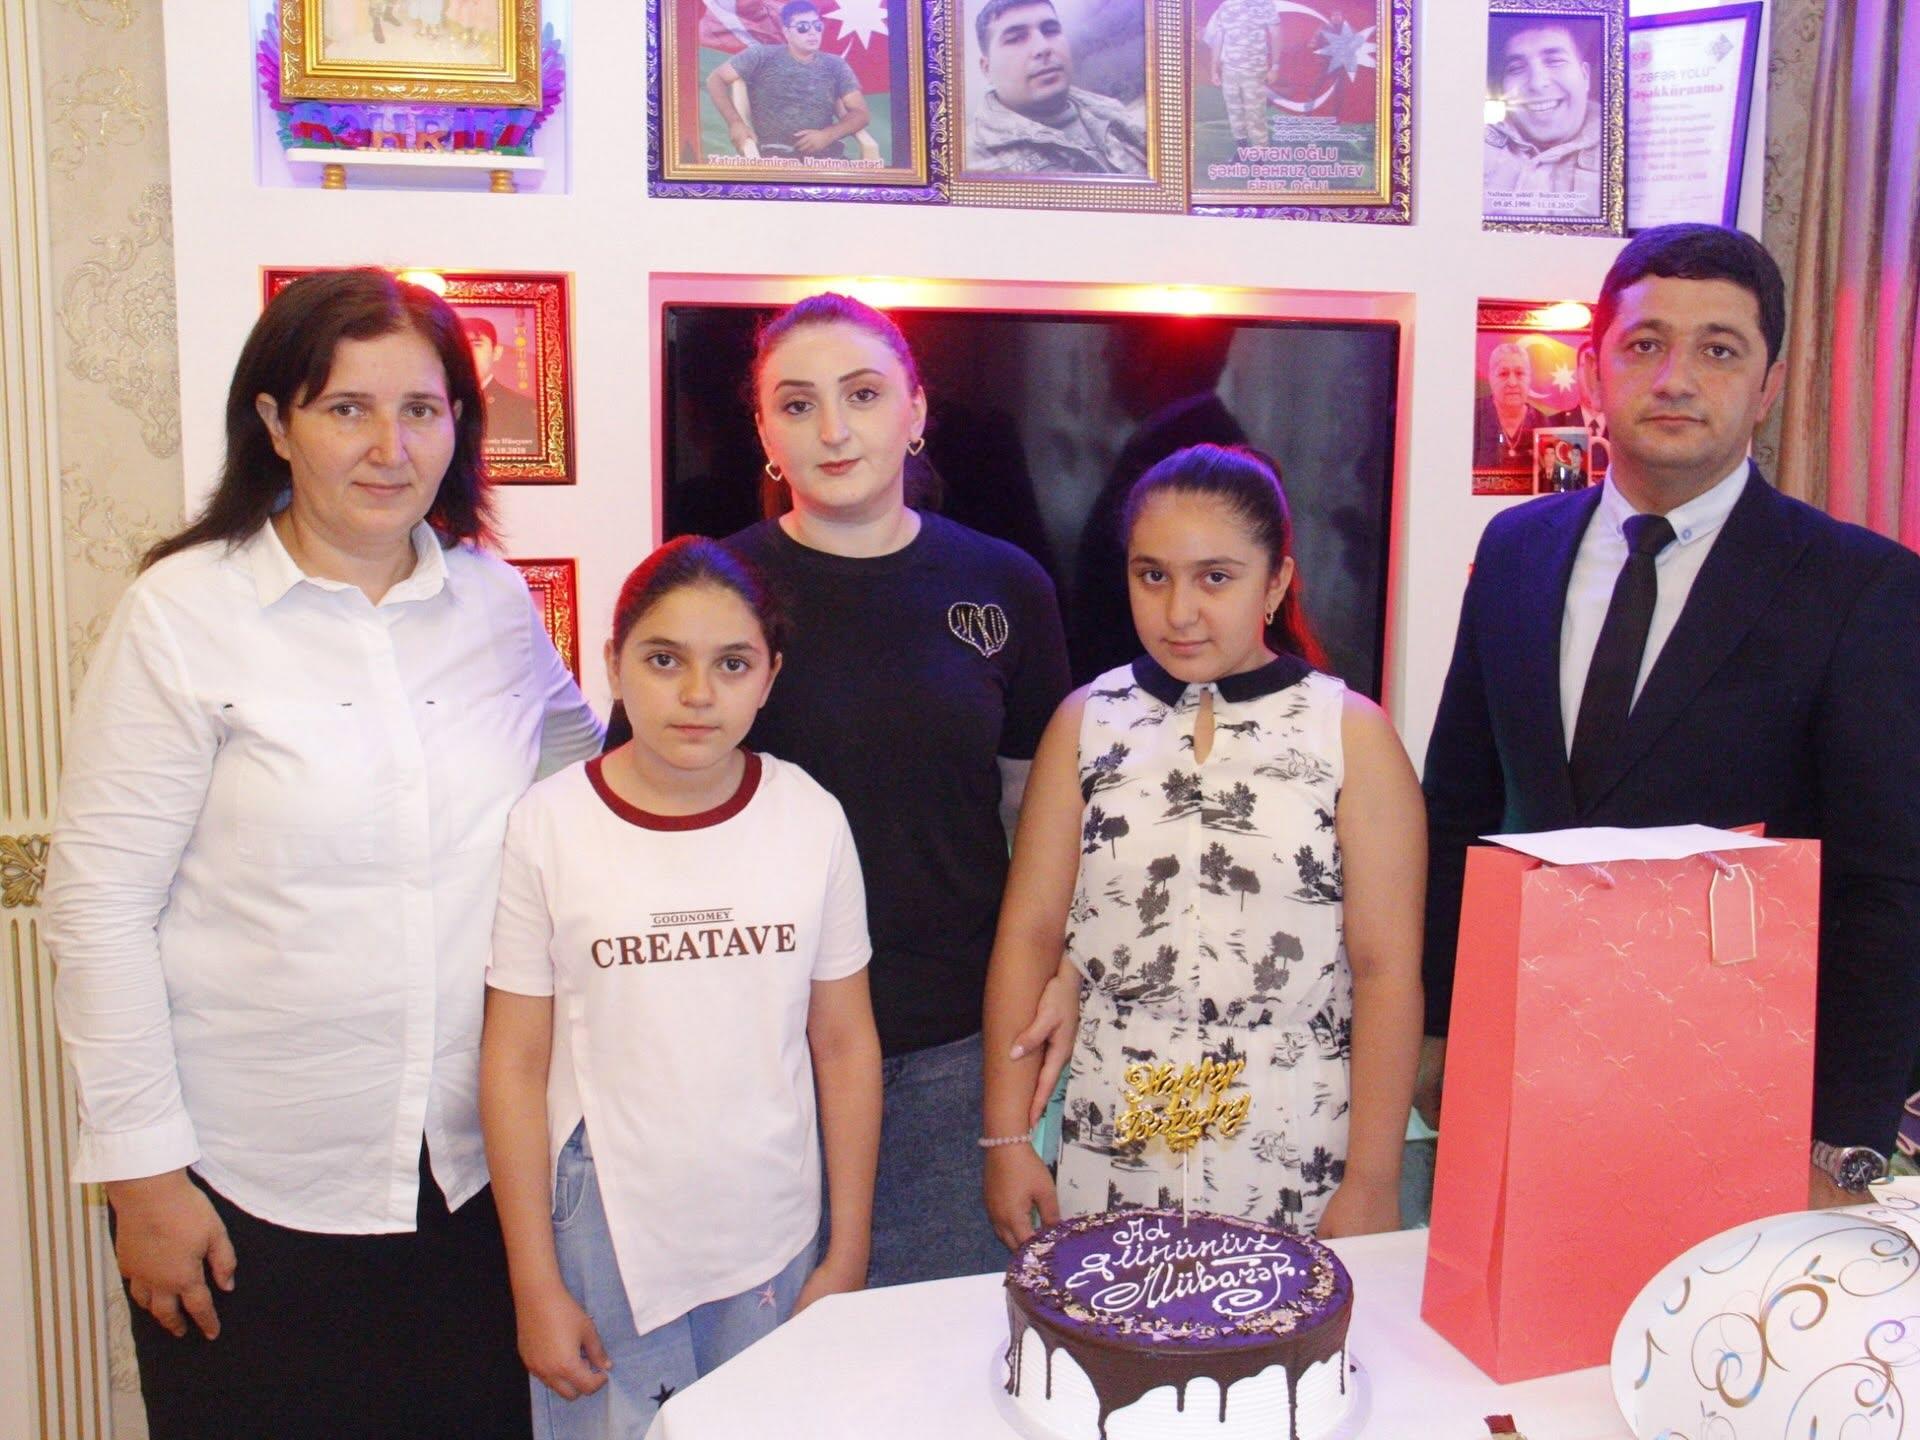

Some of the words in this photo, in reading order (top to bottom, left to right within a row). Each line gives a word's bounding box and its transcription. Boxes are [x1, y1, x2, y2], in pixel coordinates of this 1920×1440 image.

[1237, 147, 1291, 161] VƏTƏN
[1294, 144, 1338, 161] OĞLU
[1208, 163, 1249, 180] ŞƏHİD
[1251, 164, 1307, 177] BƏHRUZ
[1308, 163, 1365, 177] QULİYEV
[653, 911, 731, 924] GOODNOMEY
[591, 923, 796, 968] CREATAVE
[1113, 1218, 1170, 1245] Ad
